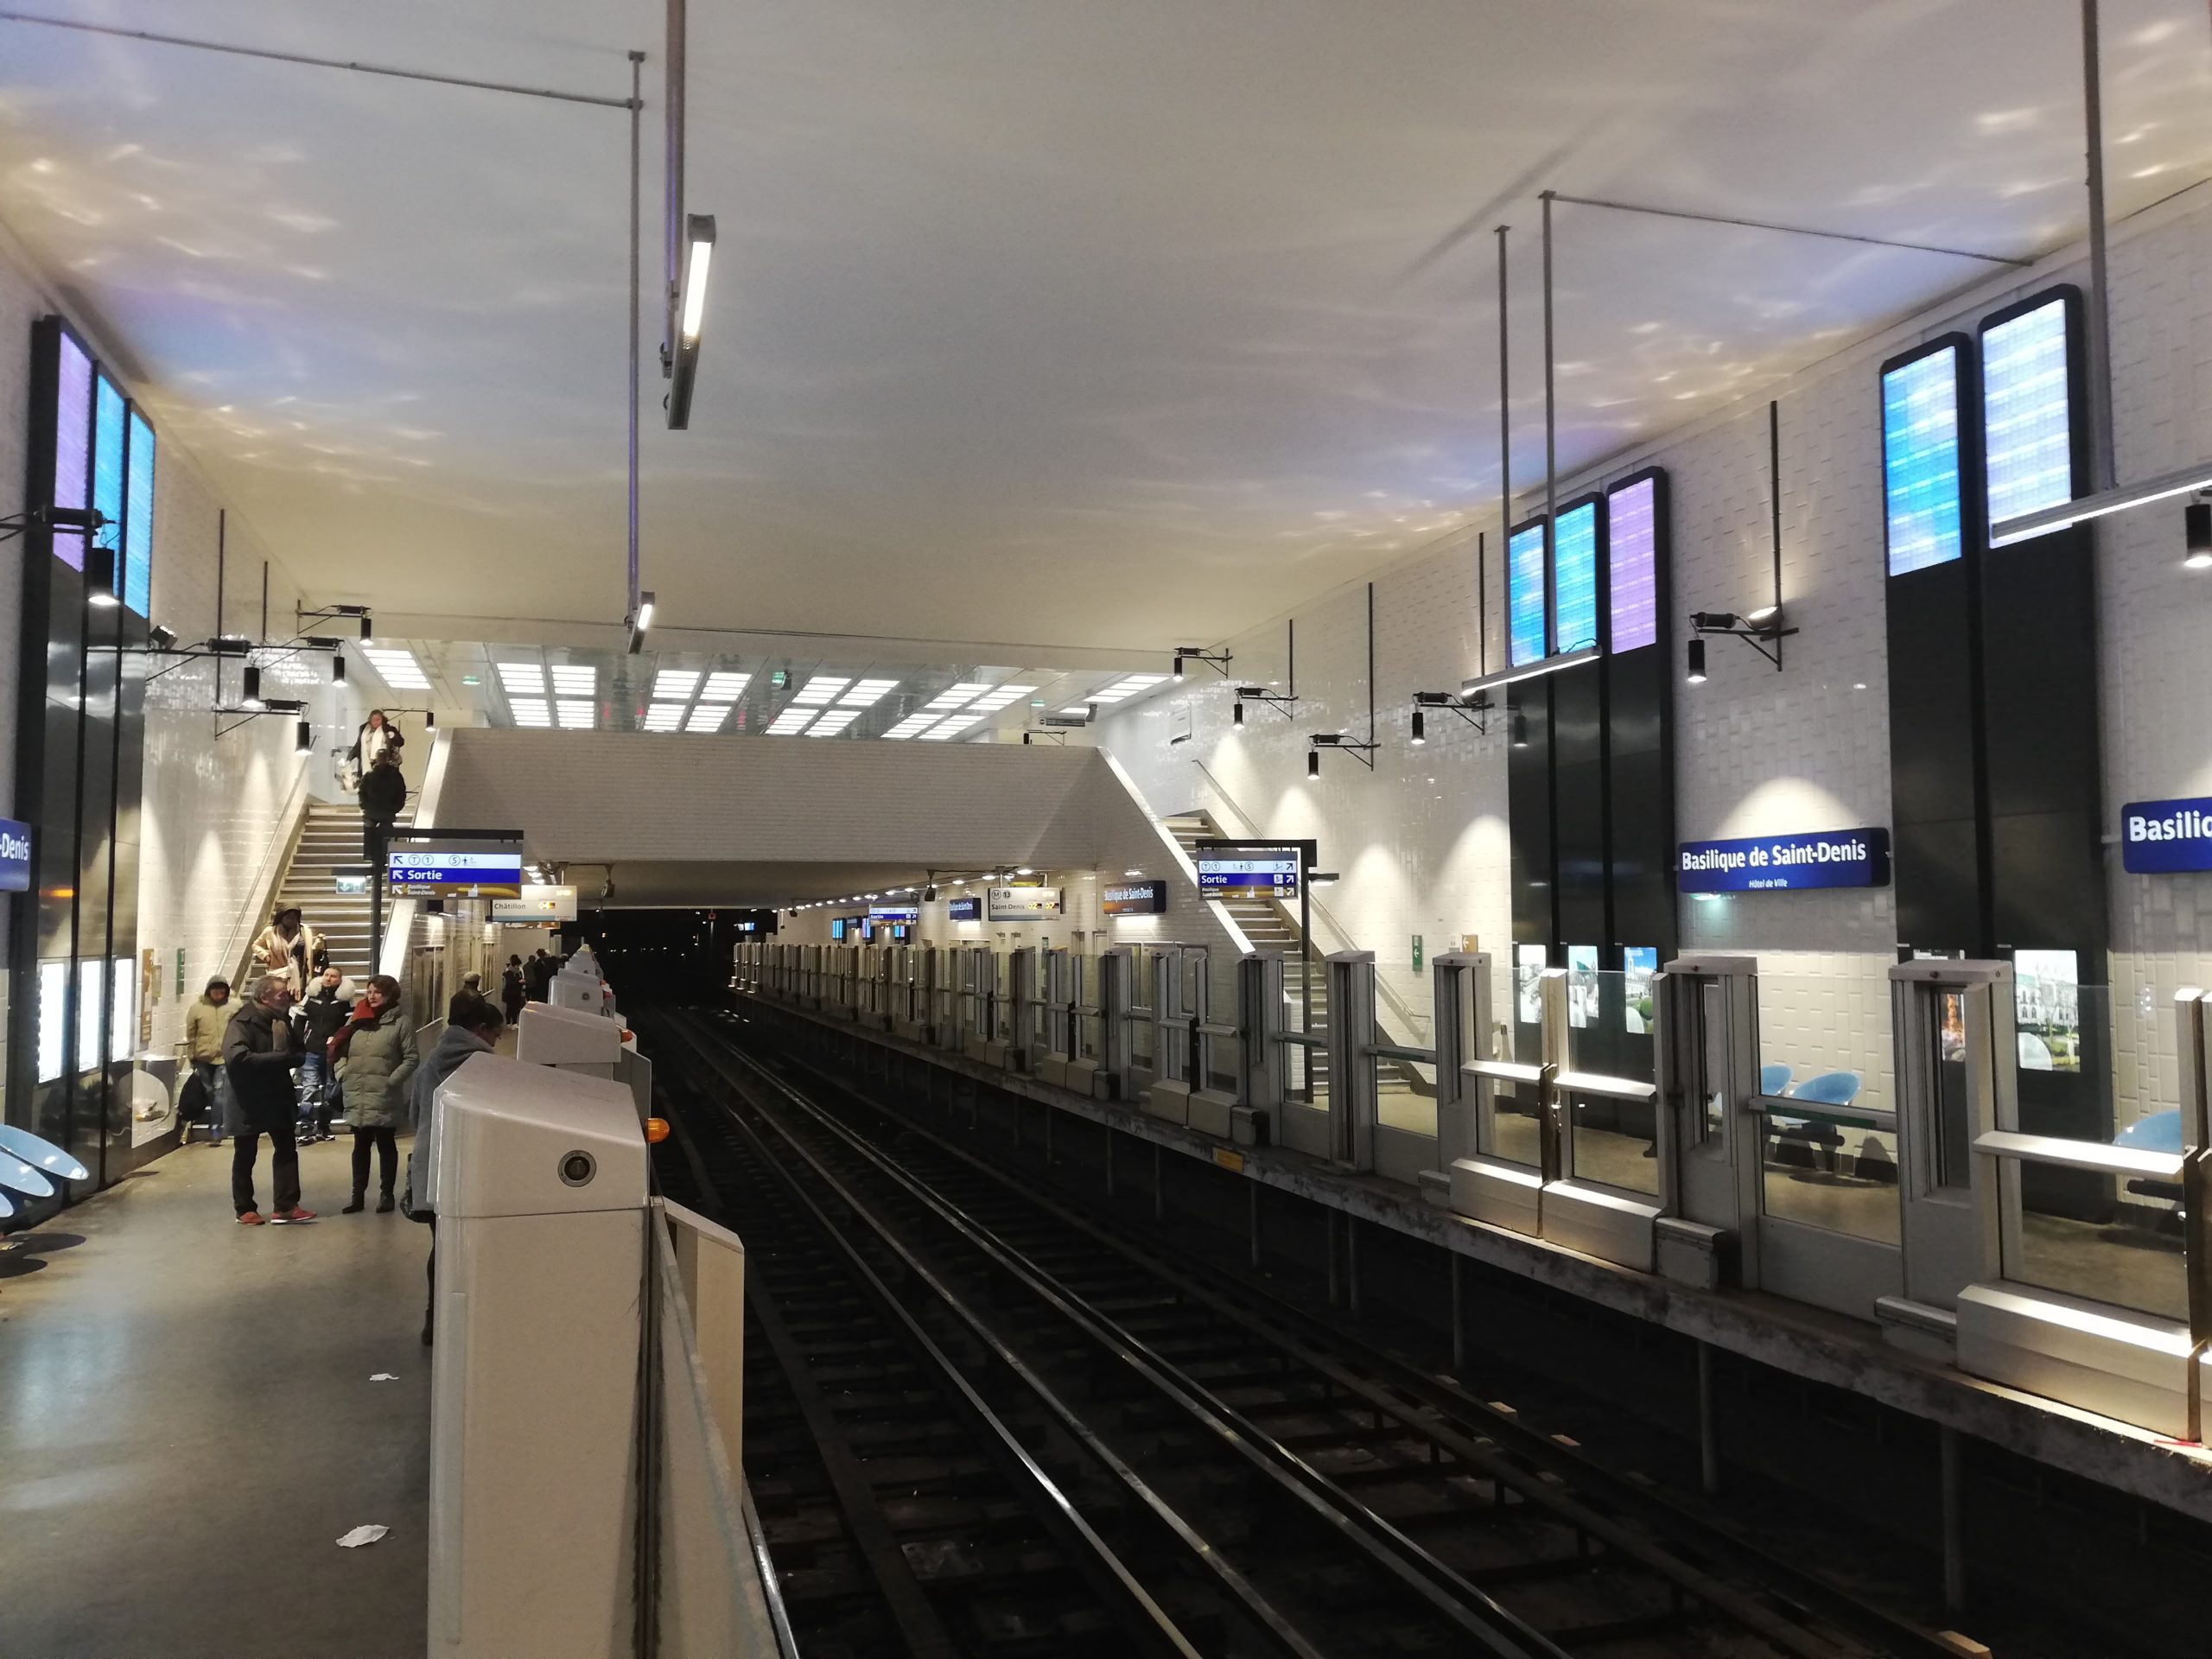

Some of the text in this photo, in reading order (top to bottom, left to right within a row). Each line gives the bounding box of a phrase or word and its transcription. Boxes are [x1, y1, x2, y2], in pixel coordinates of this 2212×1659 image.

[1682, 839, 1866, 873] Basilique de Saint-Denis
[408, 870, 442, 880] Sortie
[1129, 887, 1154, 899] Saint-Denis
